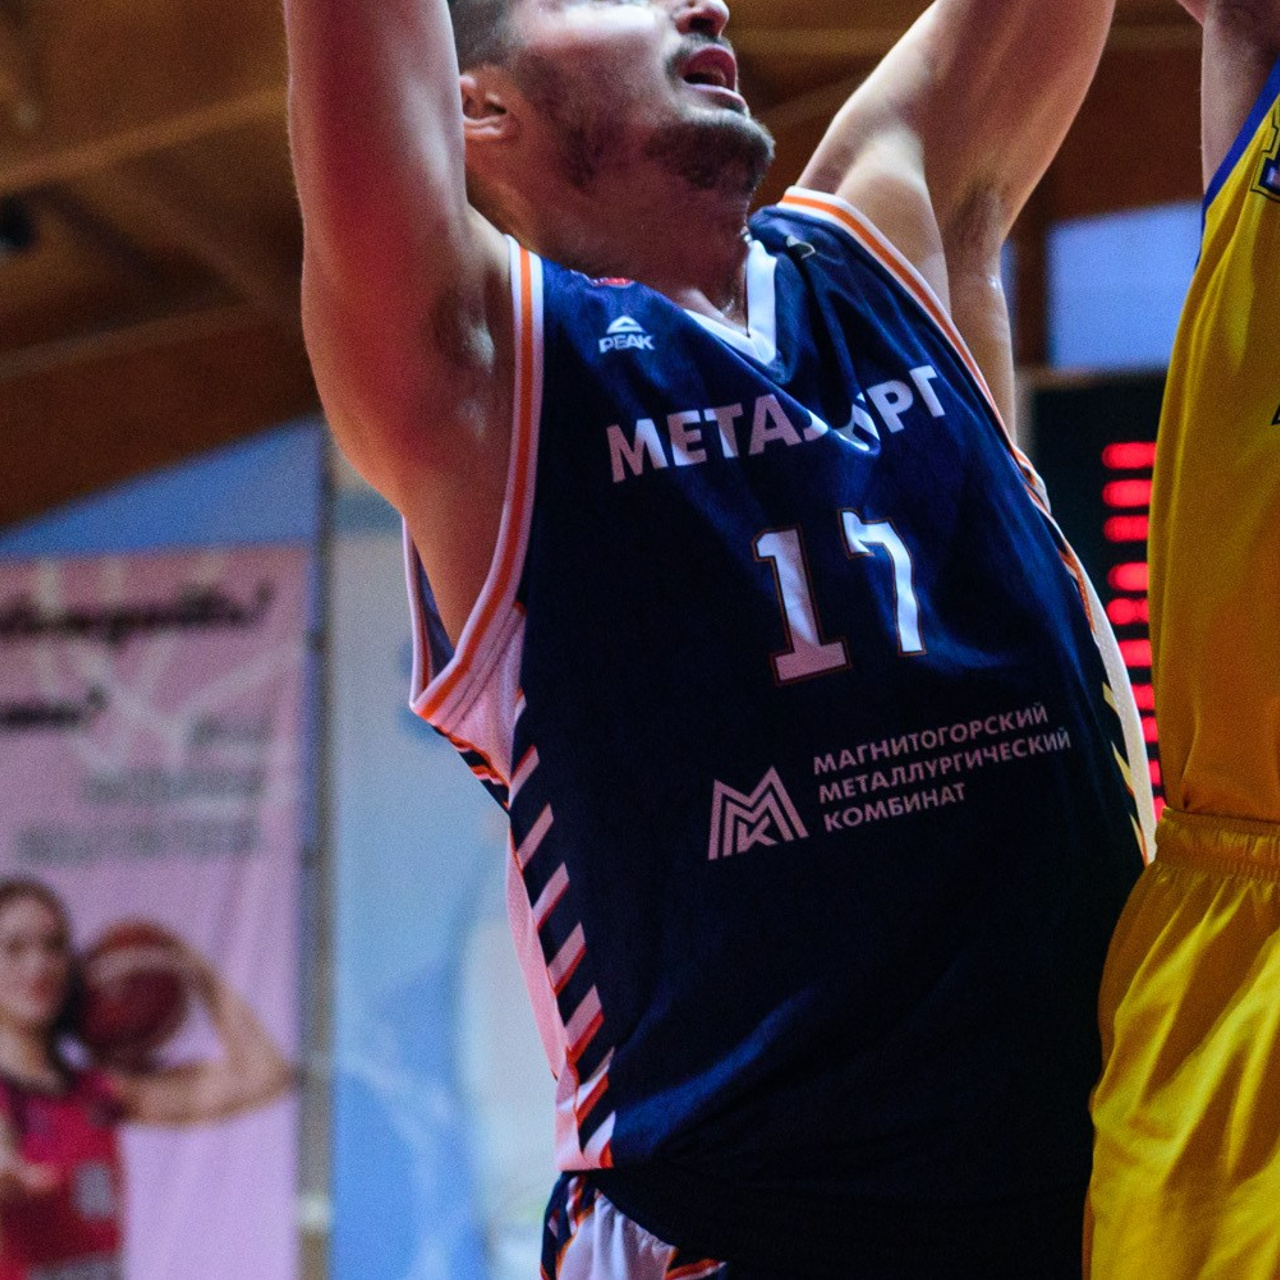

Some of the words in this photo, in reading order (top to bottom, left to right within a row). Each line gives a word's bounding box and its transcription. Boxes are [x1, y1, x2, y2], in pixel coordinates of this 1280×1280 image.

[599, 333, 656, 354] PEAK
[606, 364, 946, 483] МЕТАРГ
[752, 508, 927, 686] 17
[813, 702, 1049, 775] МАГНИТОГОРСКИЙ
[819, 727, 1072, 804] МЕТАЛЛУРГИЧЕСКИЙ
[823, 782, 966, 832] КОМБИНАТ
